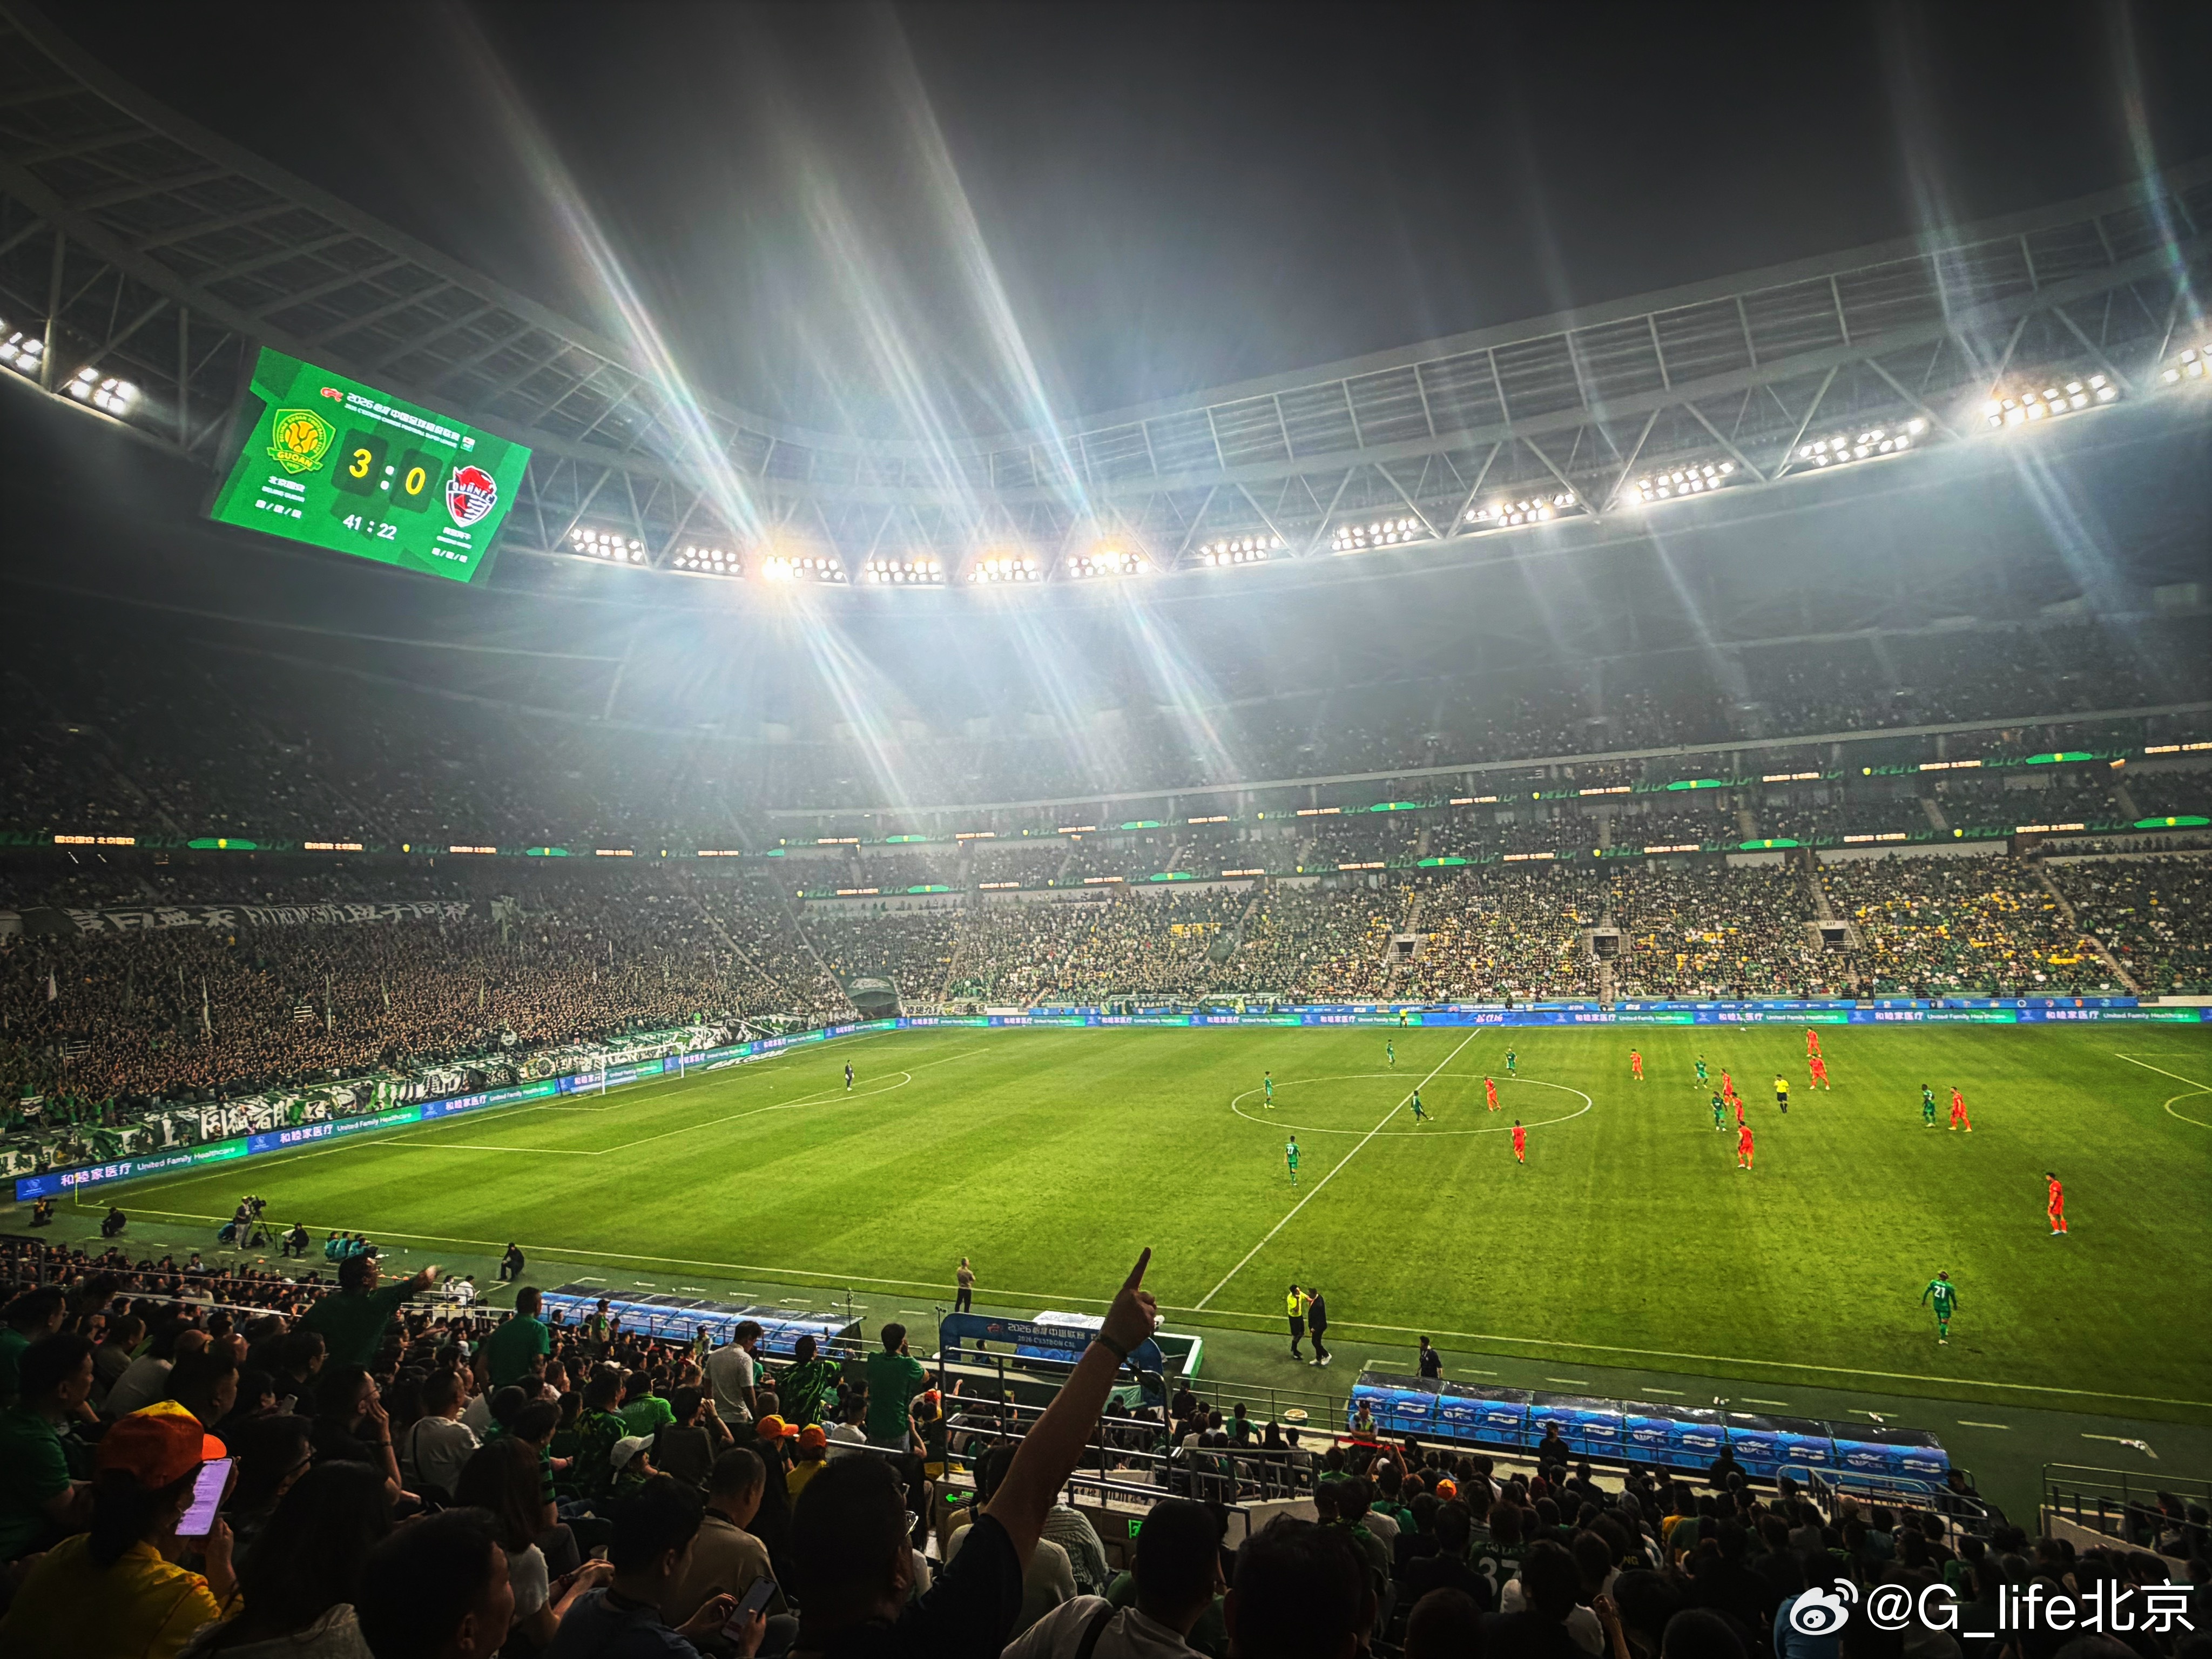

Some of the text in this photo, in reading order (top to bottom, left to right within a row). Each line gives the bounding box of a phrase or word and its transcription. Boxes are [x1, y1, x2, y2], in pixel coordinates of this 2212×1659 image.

[277, 451, 313, 468] GUOAN
[349, 449, 372, 477] 3
[406, 467, 426, 495] 0
[343, 514, 362, 531] 41
[377, 523, 397, 540] 22
[280, 1124, 334, 1144] 和睦家医疗
[60, 1147, 236, 1186] 和睦家医疗 United Family Healthcare
[1934, 1286, 1946, 1299] 21
[1008, 1323, 1031, 1333] 2026
